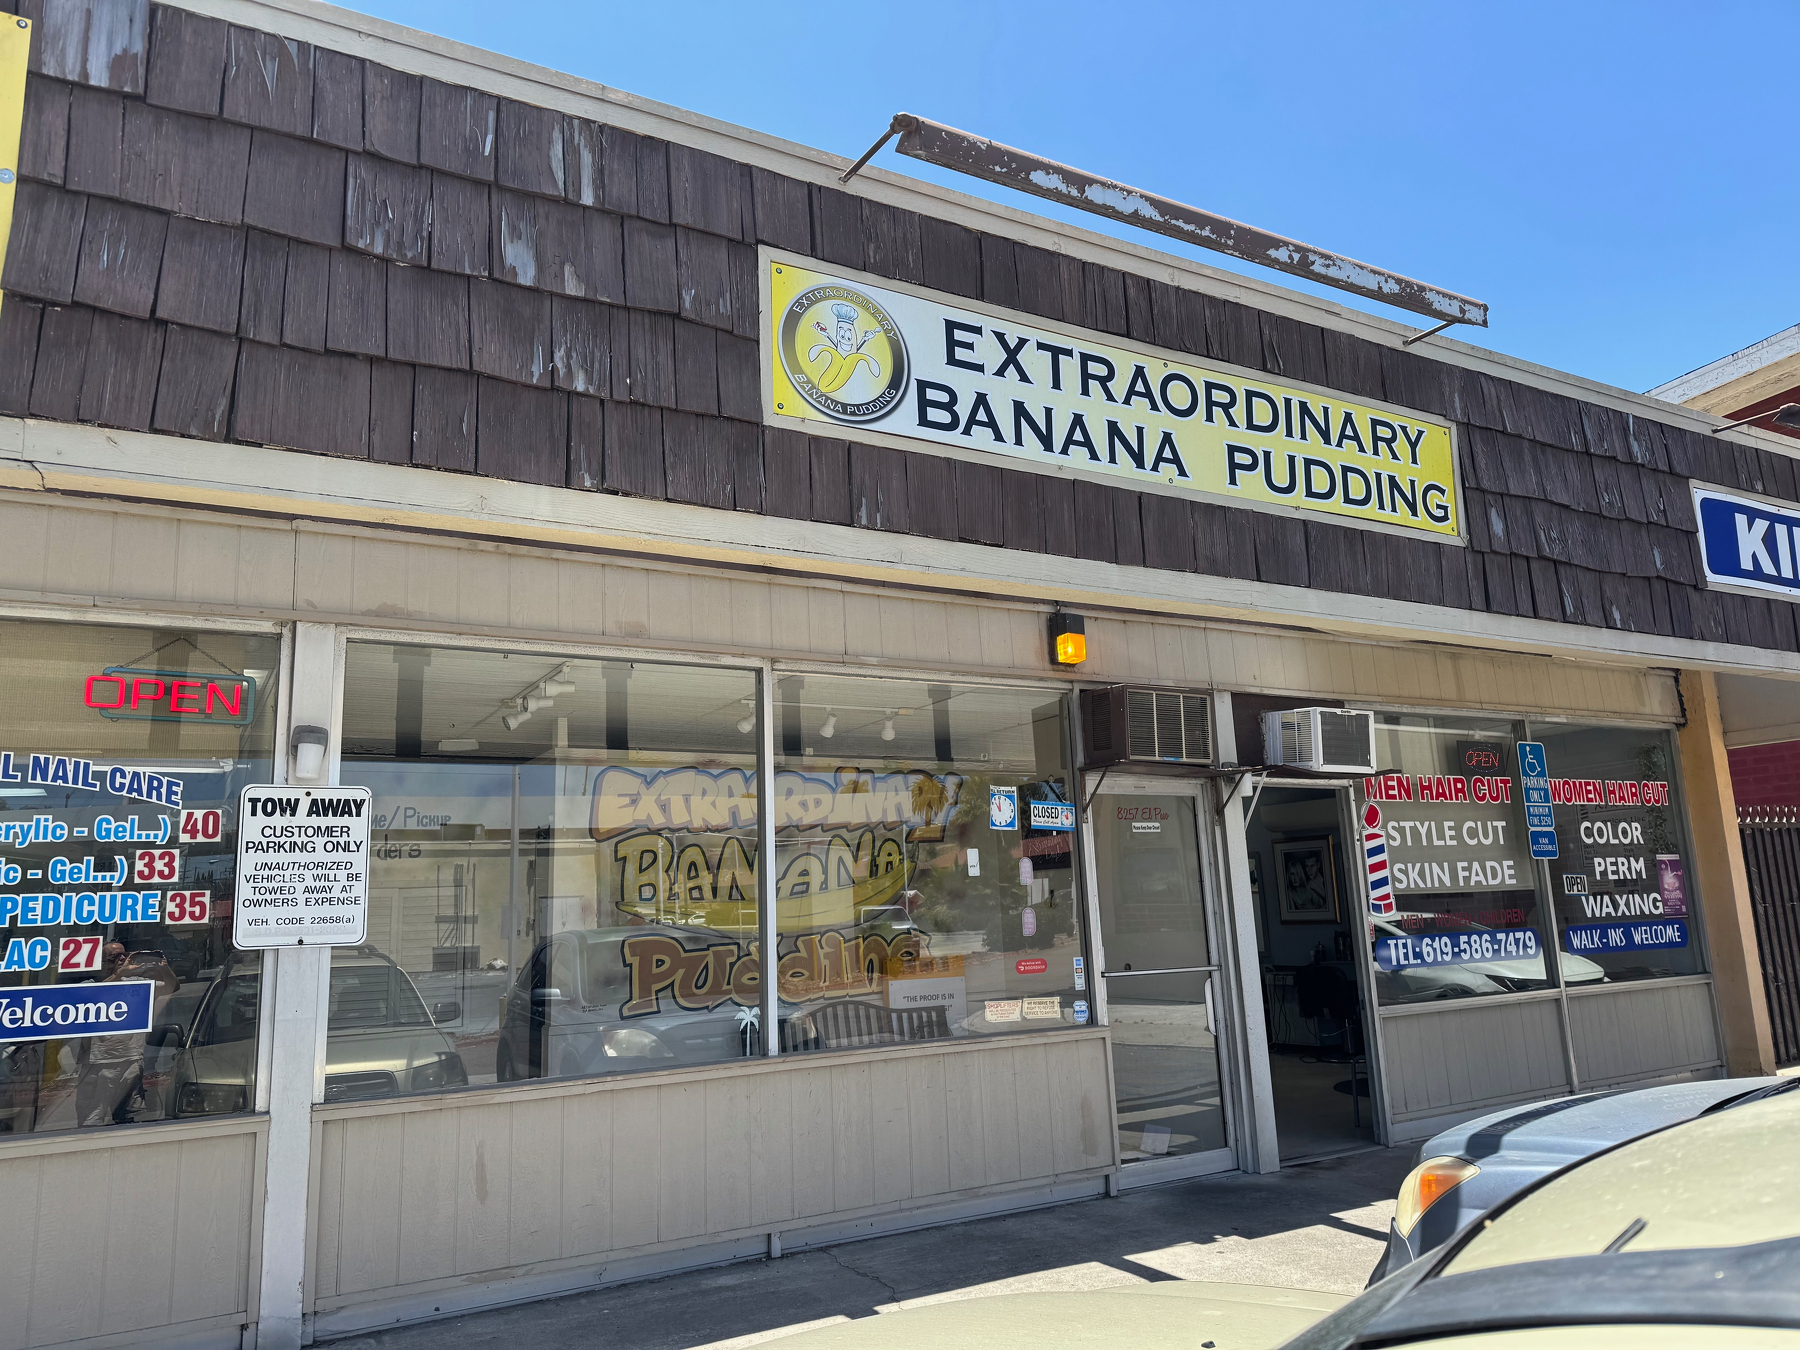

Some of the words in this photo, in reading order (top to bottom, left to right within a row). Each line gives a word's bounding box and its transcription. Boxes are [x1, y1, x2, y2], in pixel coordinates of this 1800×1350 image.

[792, 288, 898, 341] EXTRAORDINARY
[794, 373, 843, 413] BANANA
[847, 388, 896, 415] PUDDING
[943, 318, 1425, 467] EXTRAORDINARY
[914, 378, 1190, 478] BANANA
[1225, 443, 1450, 524] PUDDING
[1734, 512, 1800, 583] KI
[84, 675, 242, 716] OPEN
[1465, 750, 1499, 767] OPEN
[28, 753, 100, 791] NAIL
[107, 765, 183, 809] CARE
[1364, 774, 1413, 802] MEN
[1417, 774, 1467, 803] HAIR
[1471, 775, 1512, 804] CUT
[1523, 776, 1548, 789] PARKING
[1549, 778, 1603, 804] WOMEN
[1606, 780, 1641, 806] HAIR
[1641, 781, 1668, 806] CUT
[247, 797, 301, 818] TOW
[306, 798, 367, 818] AWAY
[1529, 790, 1545, 802] ONLY
[1032, 805, 1059, 820] CLOSED
[1116, 806, 1139, 821] 8257
[1141, 806, 1152, 820] El
[94, 815, 171, 845] Gel...)
[181, 811, 221, 839] 40
[261, 825, 351, 838] CUSTOMER
[1387, 821, 1458, 846] STYLE
[1462, 821, 1507, 845] CUT
[1580, 821, 1645, 845] COLOR
[245, 840, 316, 854] PARKING
[323, 840, 363, 853] ONLY
[48, 856, 128, 886] Gel...)
[137, 851, 177, 881] 33
[244, 873, 305, 884] VEHICLES
[312, 873, 340, 883] WILL
[346, 872, 362, 882] BE
[254, 861, 353, 872] UNAUTHORIZED
[1393, 862, 1451, 889] SKIN
[1457, 860, 1517, 886] FADE
[1593, 856, 1647, 880] PERM
[251, 885, 296, 895] TOWED
[302, 885, 335, 895] AWAY
[340, 884, 355, 894] AT
[1565, 875, 1586, 893] OPEN
[0, 891, 161, 927] PEDICURE
[168, 892, 207, 922] 35
[242, 897, 298, 908] OWNERS
[304, 896, 361, 907] EXPENSE
[1581, 892, 1664, 918] WAXING
[247, 918, 271, 927] VEH.
[276, 917, 305, 926] CODE
[310, 914, 355, 925] 22658(a)
[1401, 913, 1425, 929] MEN
[1433, 911, 1472, 928] WOMEN
[1480, 908, 1525, 925] CHILDREN
[1569, 926, 1626, 950] WALK-INS
[1631, 924, 1682, 945] WELCOME
[0, 936, 51, 972] AC
[61, 938, 101, 970] 27
[919, 994, 939, 1002] PROOF
[947, 992, 955, 1000] IN
[986, 1002, 1019, 1010] SHOPLIFTERS
